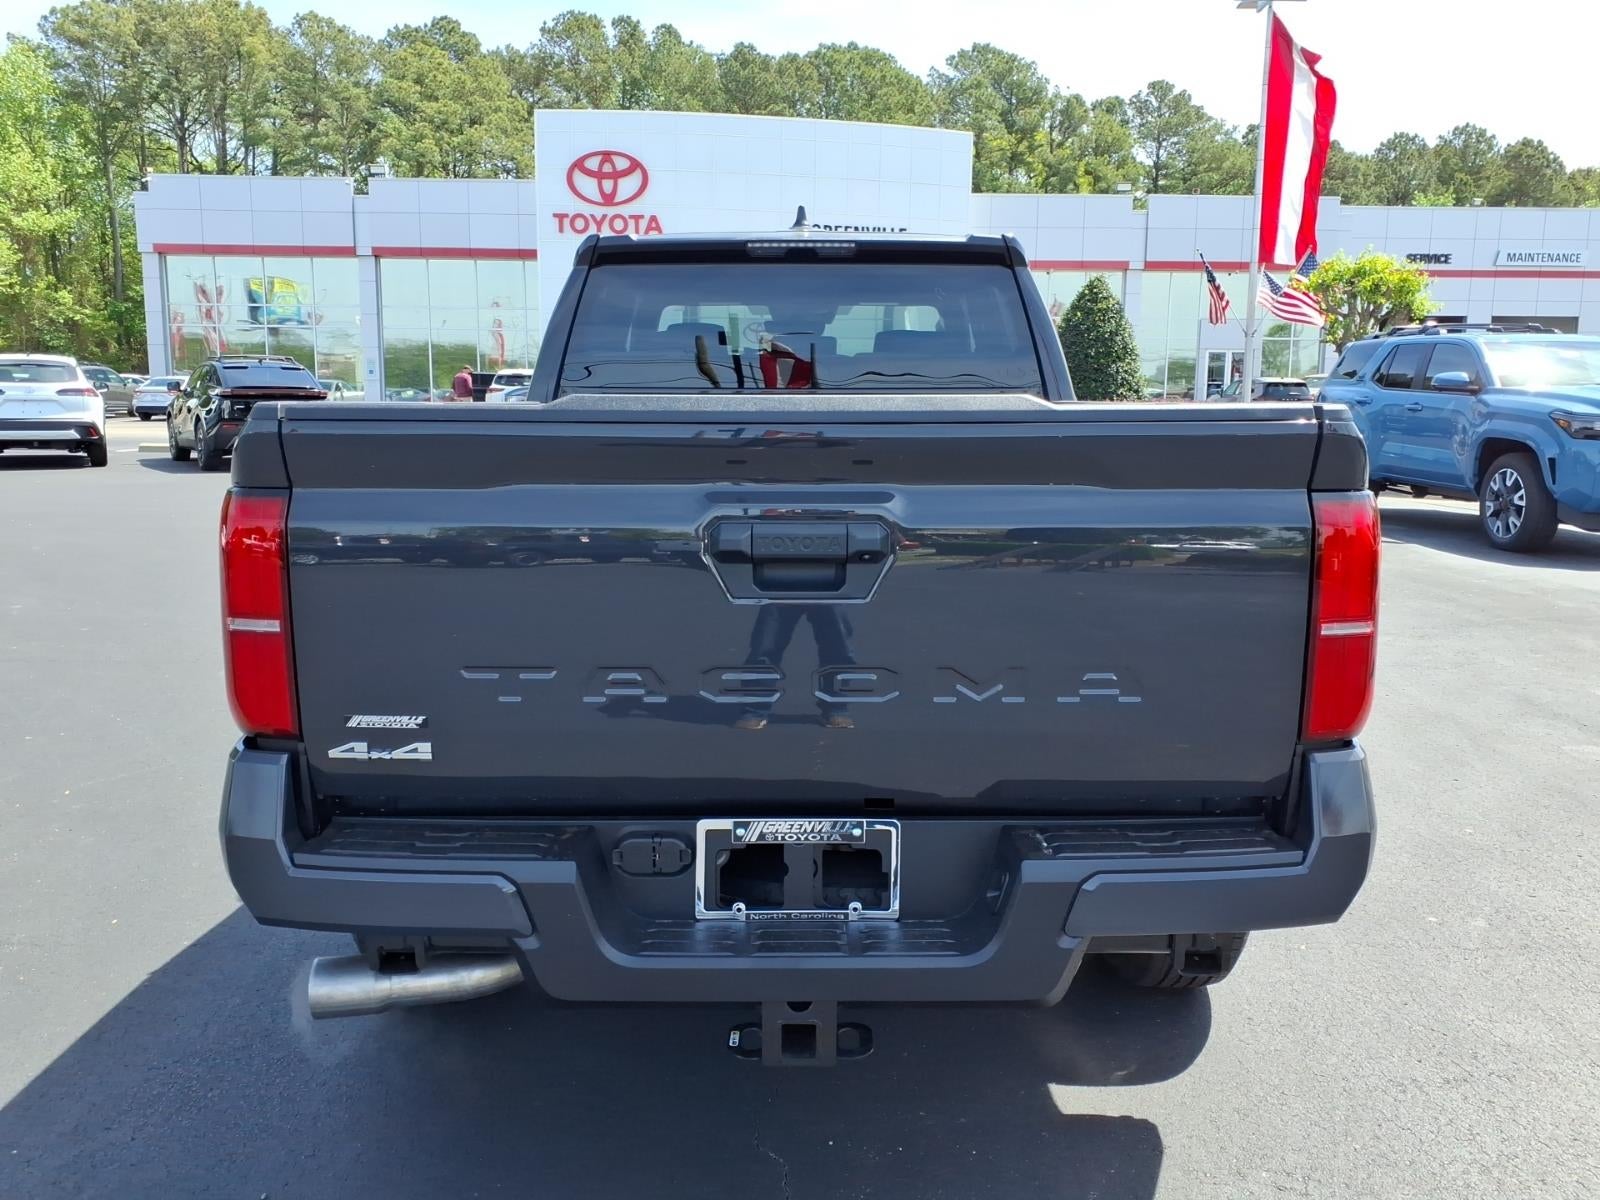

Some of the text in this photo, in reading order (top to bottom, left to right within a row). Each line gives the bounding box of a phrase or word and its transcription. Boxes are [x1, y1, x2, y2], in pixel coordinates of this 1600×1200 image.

[552, 212, 663, 235] TOYOTA
[1406, 252, 1452, 265] SERVICE
[1506, 252, 1582, 264] MAINTENANCE
[758, 535, 841, 552] TOYOTA
[460, 665, 1142, 705] TACOMA
[774, 833, 842, 841] TOYOTA
[750, 912, 845, 921] North Carolina
